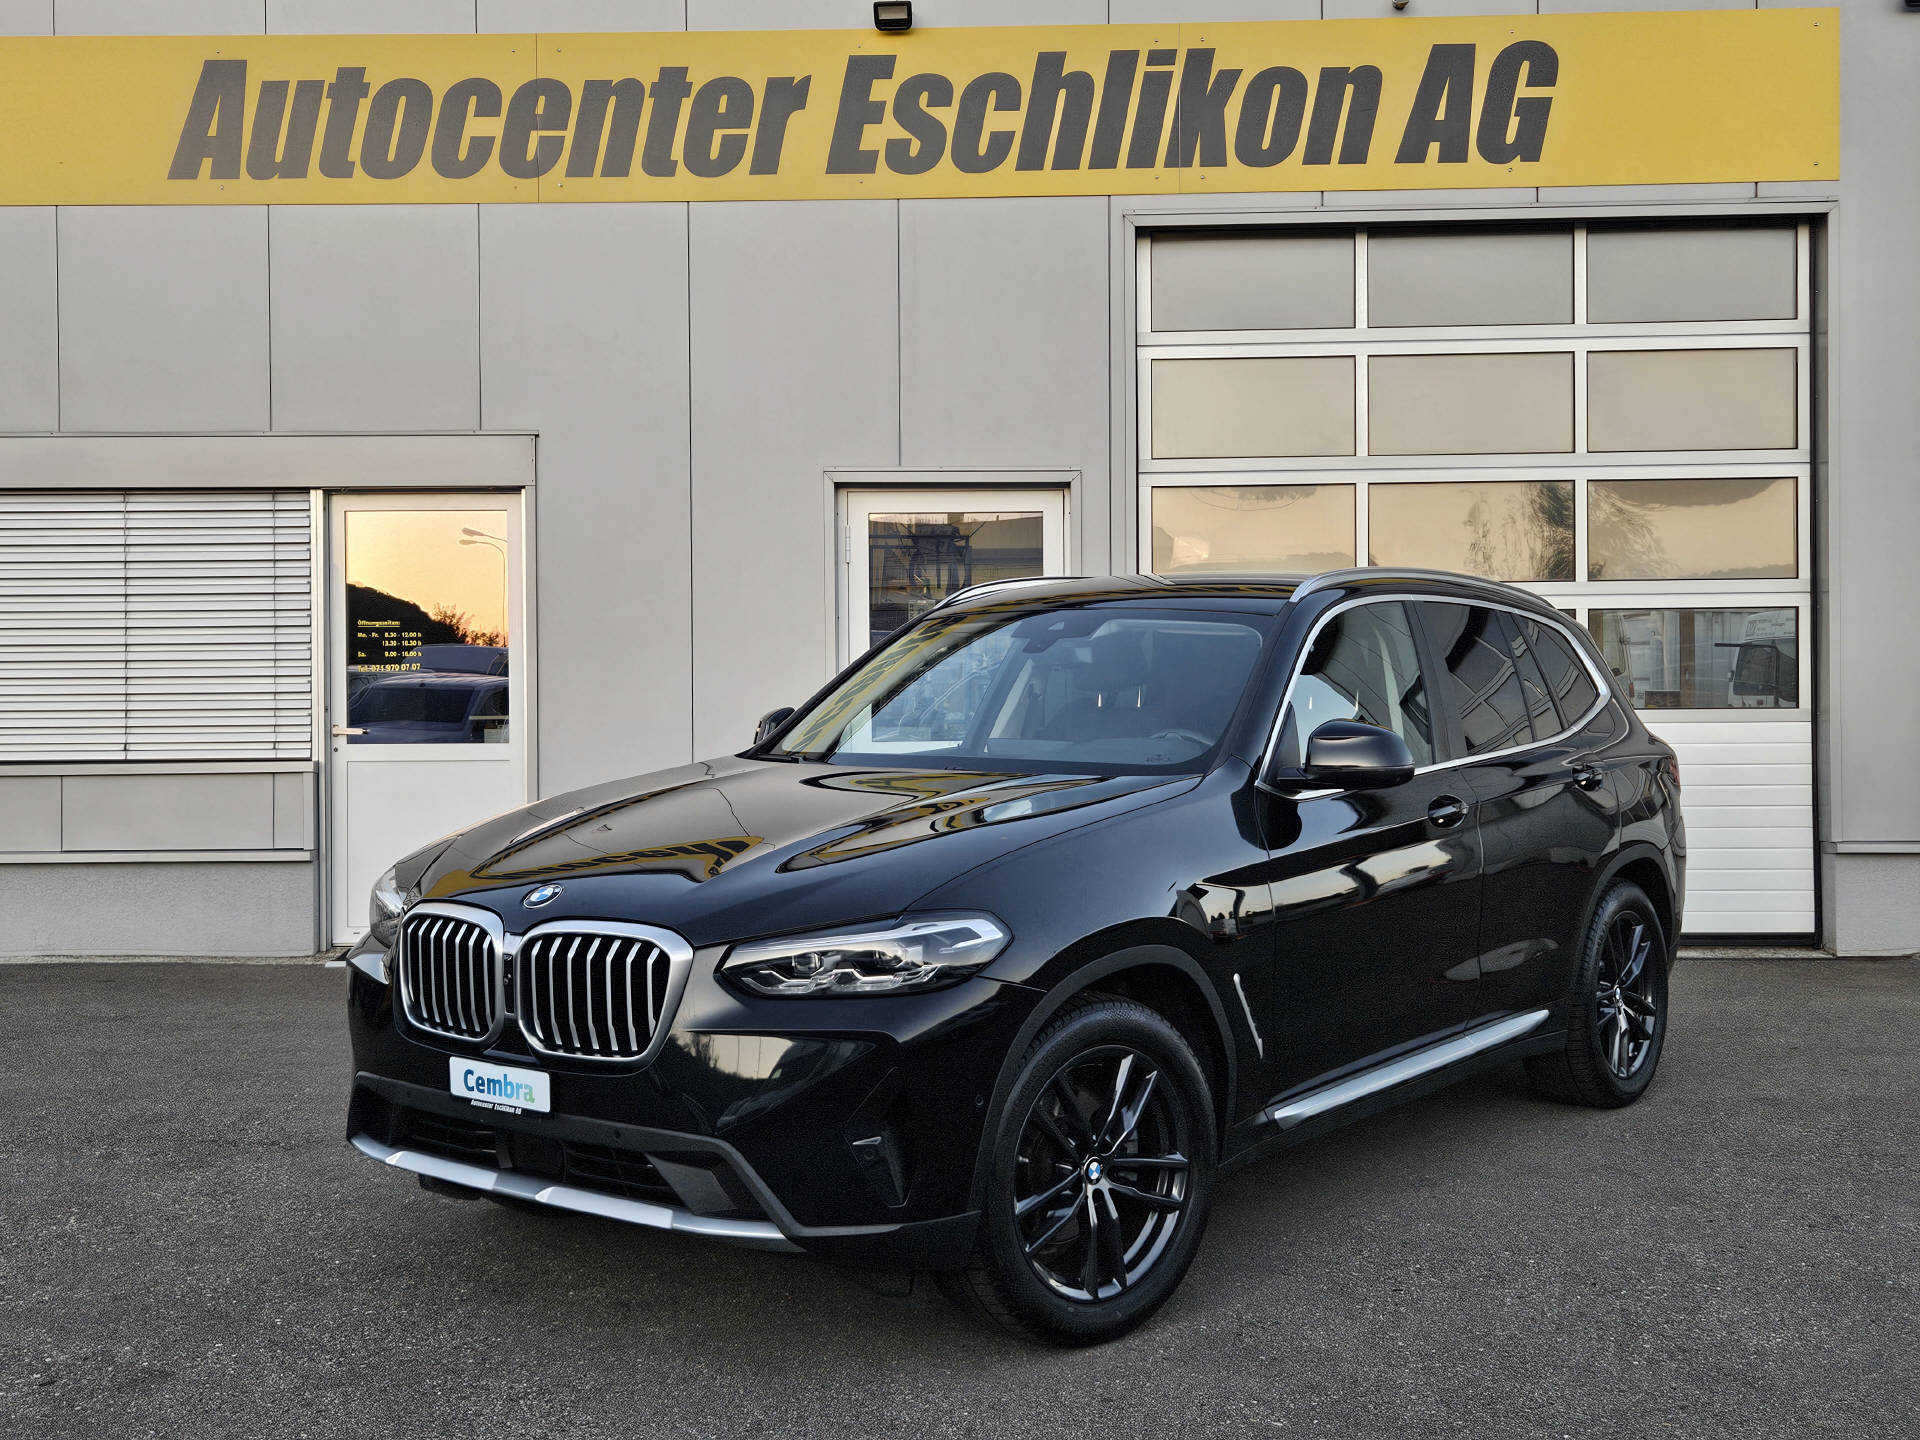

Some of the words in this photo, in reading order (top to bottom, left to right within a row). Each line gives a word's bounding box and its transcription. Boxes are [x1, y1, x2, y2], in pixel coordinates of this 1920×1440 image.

[167, 59, 812, 181] Autocenter
[825, 47, 1383, 175] Eschlikon
[1394, 40, 1560, 165] AG
[401, 663, 410, 671] 07
[411, 663, 421, 671] 07
[463, 1069, 536, 1104] Cembra
